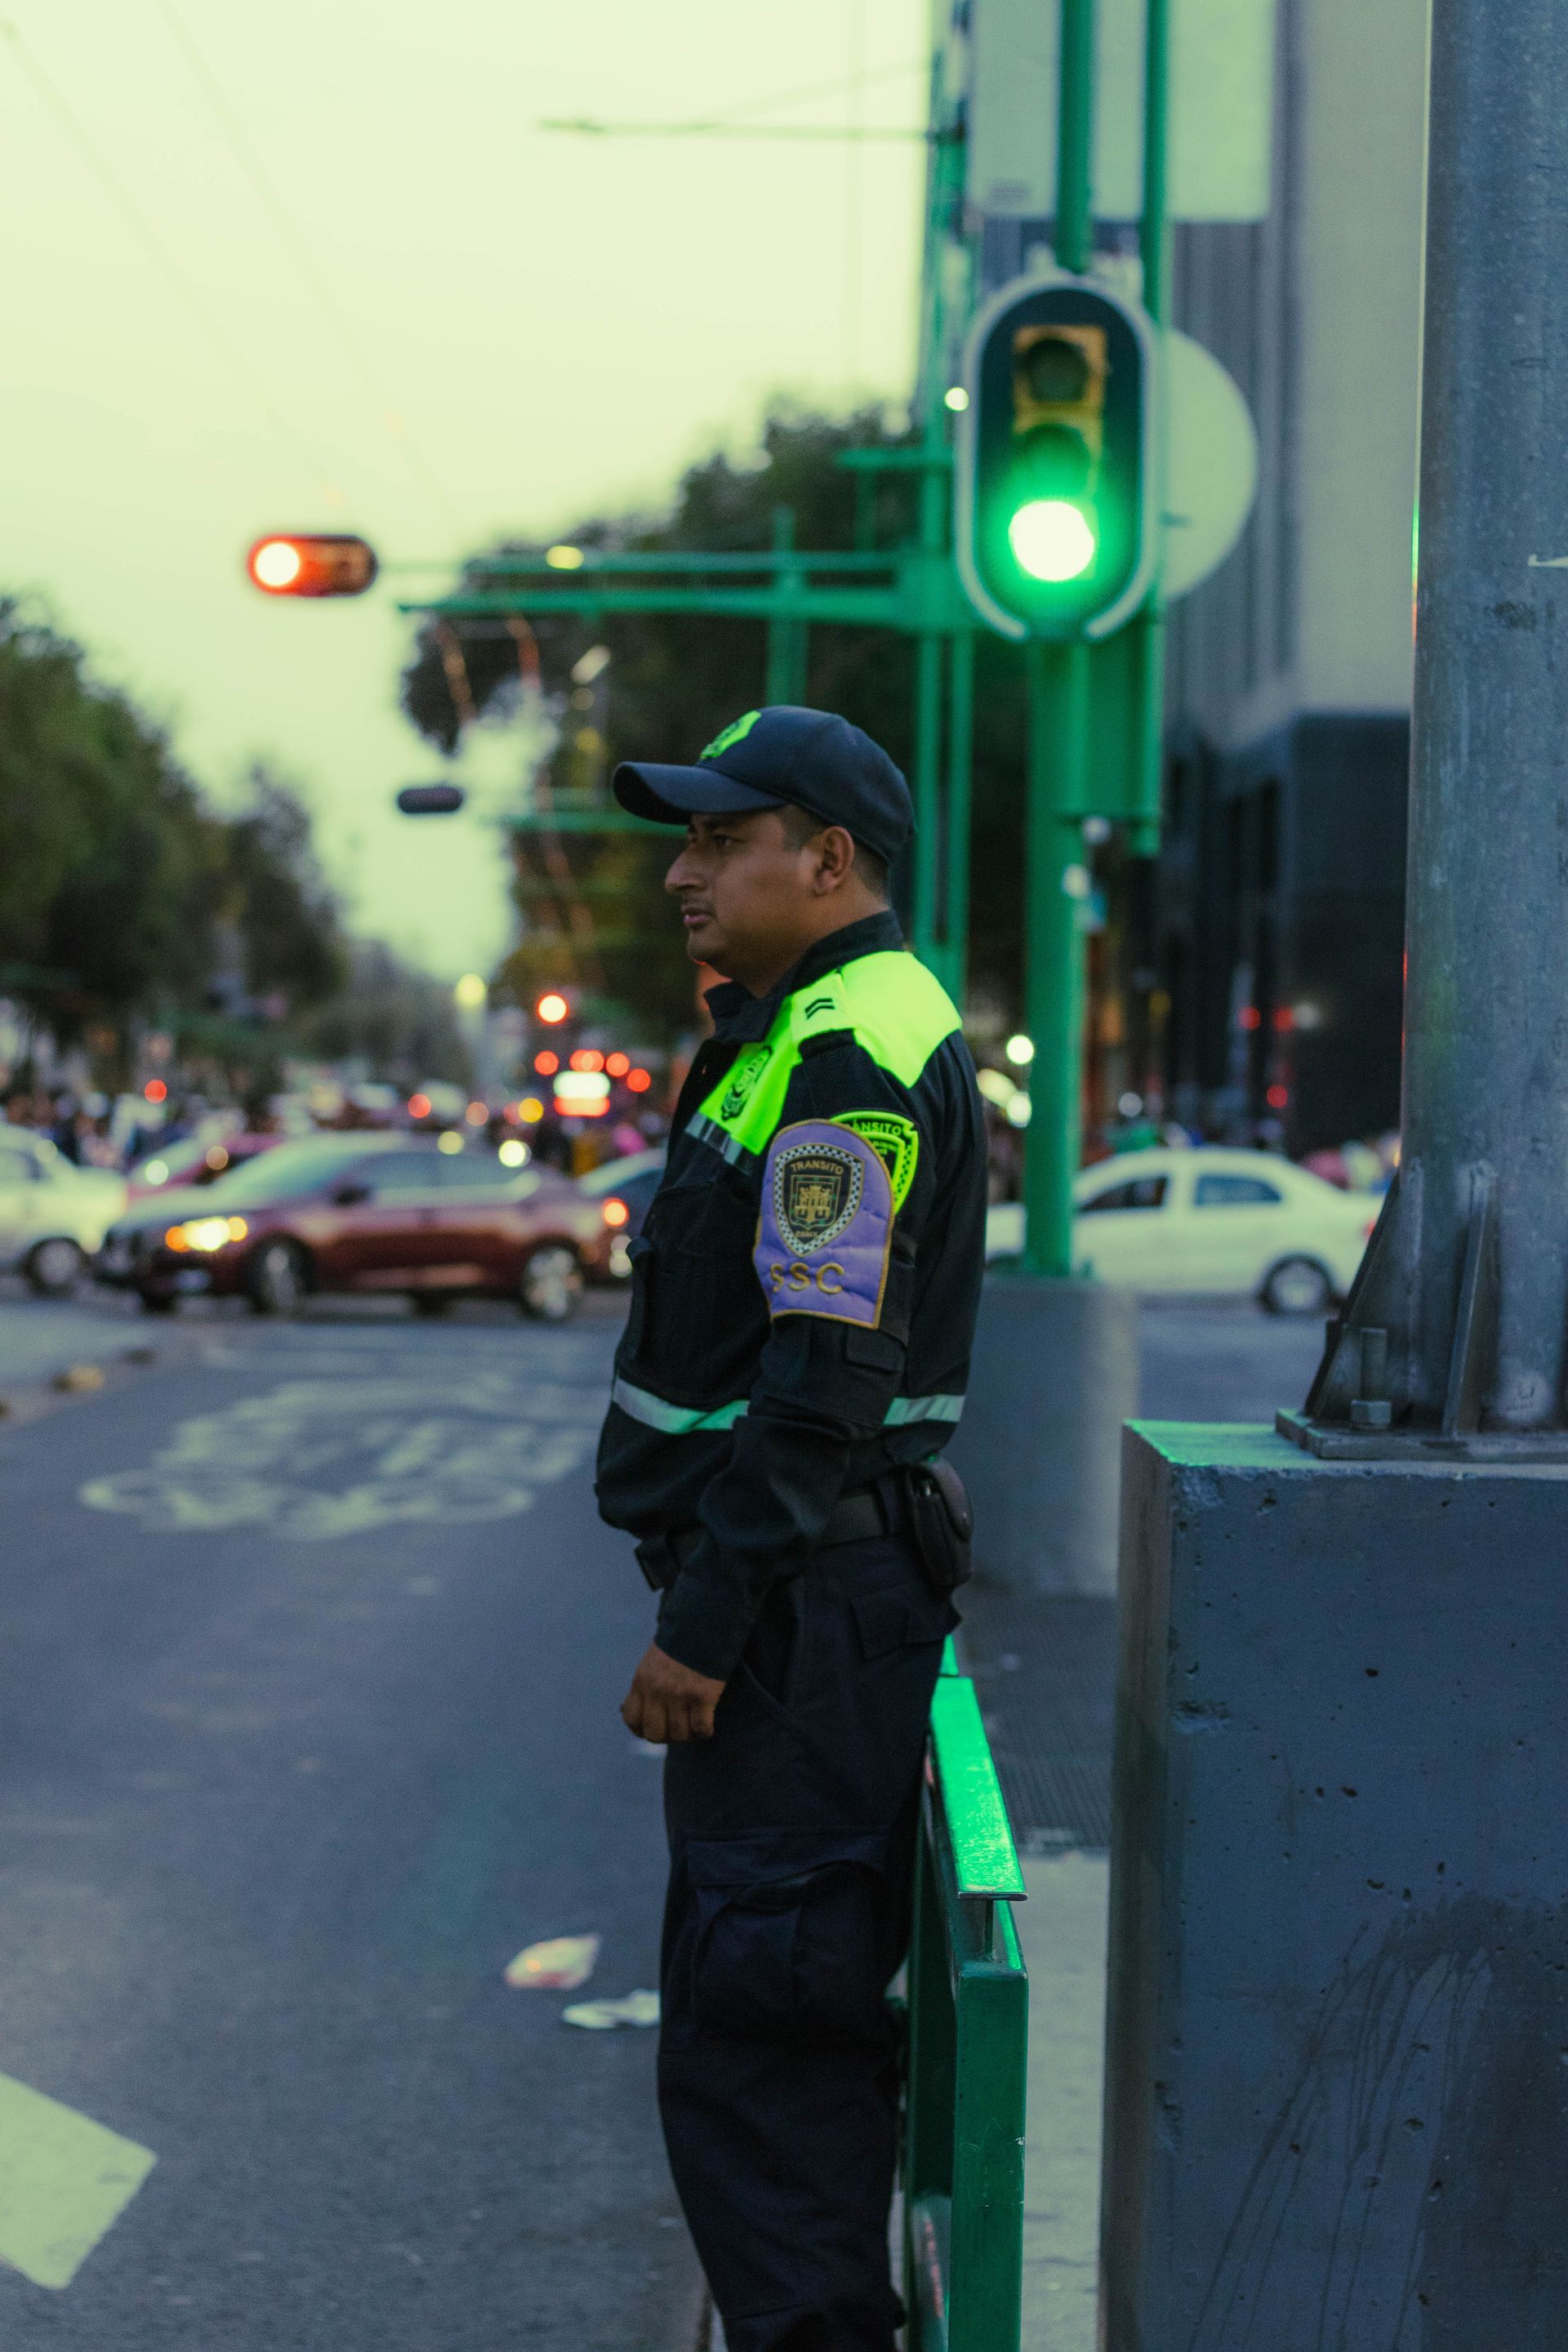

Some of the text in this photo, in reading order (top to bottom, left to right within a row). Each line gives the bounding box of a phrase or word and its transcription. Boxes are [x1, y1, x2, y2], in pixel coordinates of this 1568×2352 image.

[851, 1119, 902, 1136] ÁNSITO
[790, 1160, 844, 1174] TRANSITO
[770, 1262, 845, 1294] SSC
